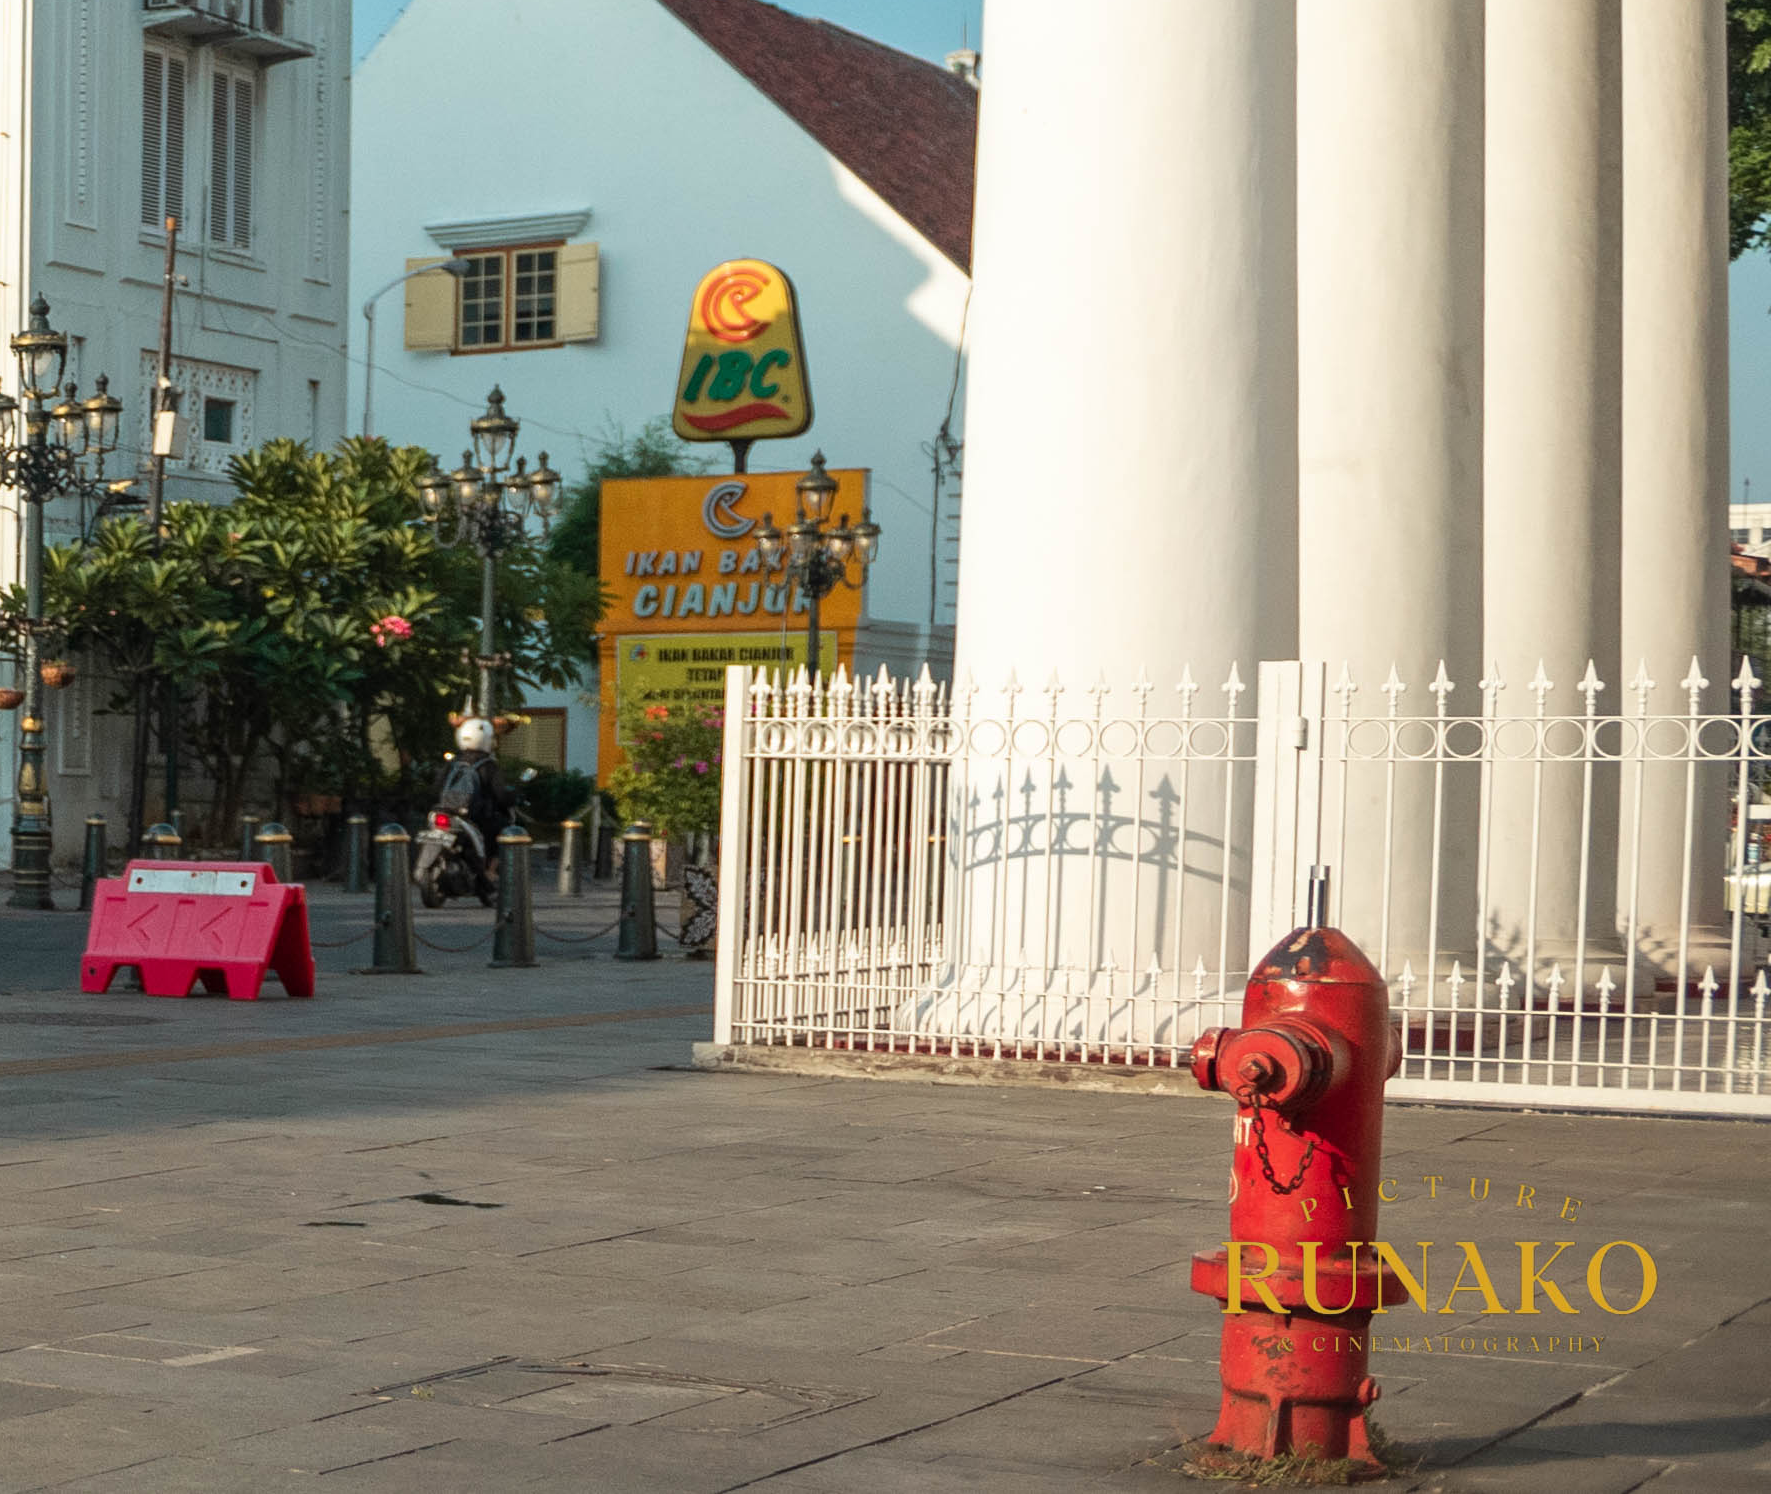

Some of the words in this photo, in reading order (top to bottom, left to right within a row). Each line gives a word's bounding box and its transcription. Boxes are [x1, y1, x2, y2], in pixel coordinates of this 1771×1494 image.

[682, 348, 790, 402] IBC
[625, 550, 703, 576] IKAN
[659, 648, 688, 662] IKAN
[692, 648, 735, 661] BAKAR
[739, 647, 794, 661] CIANJUR
